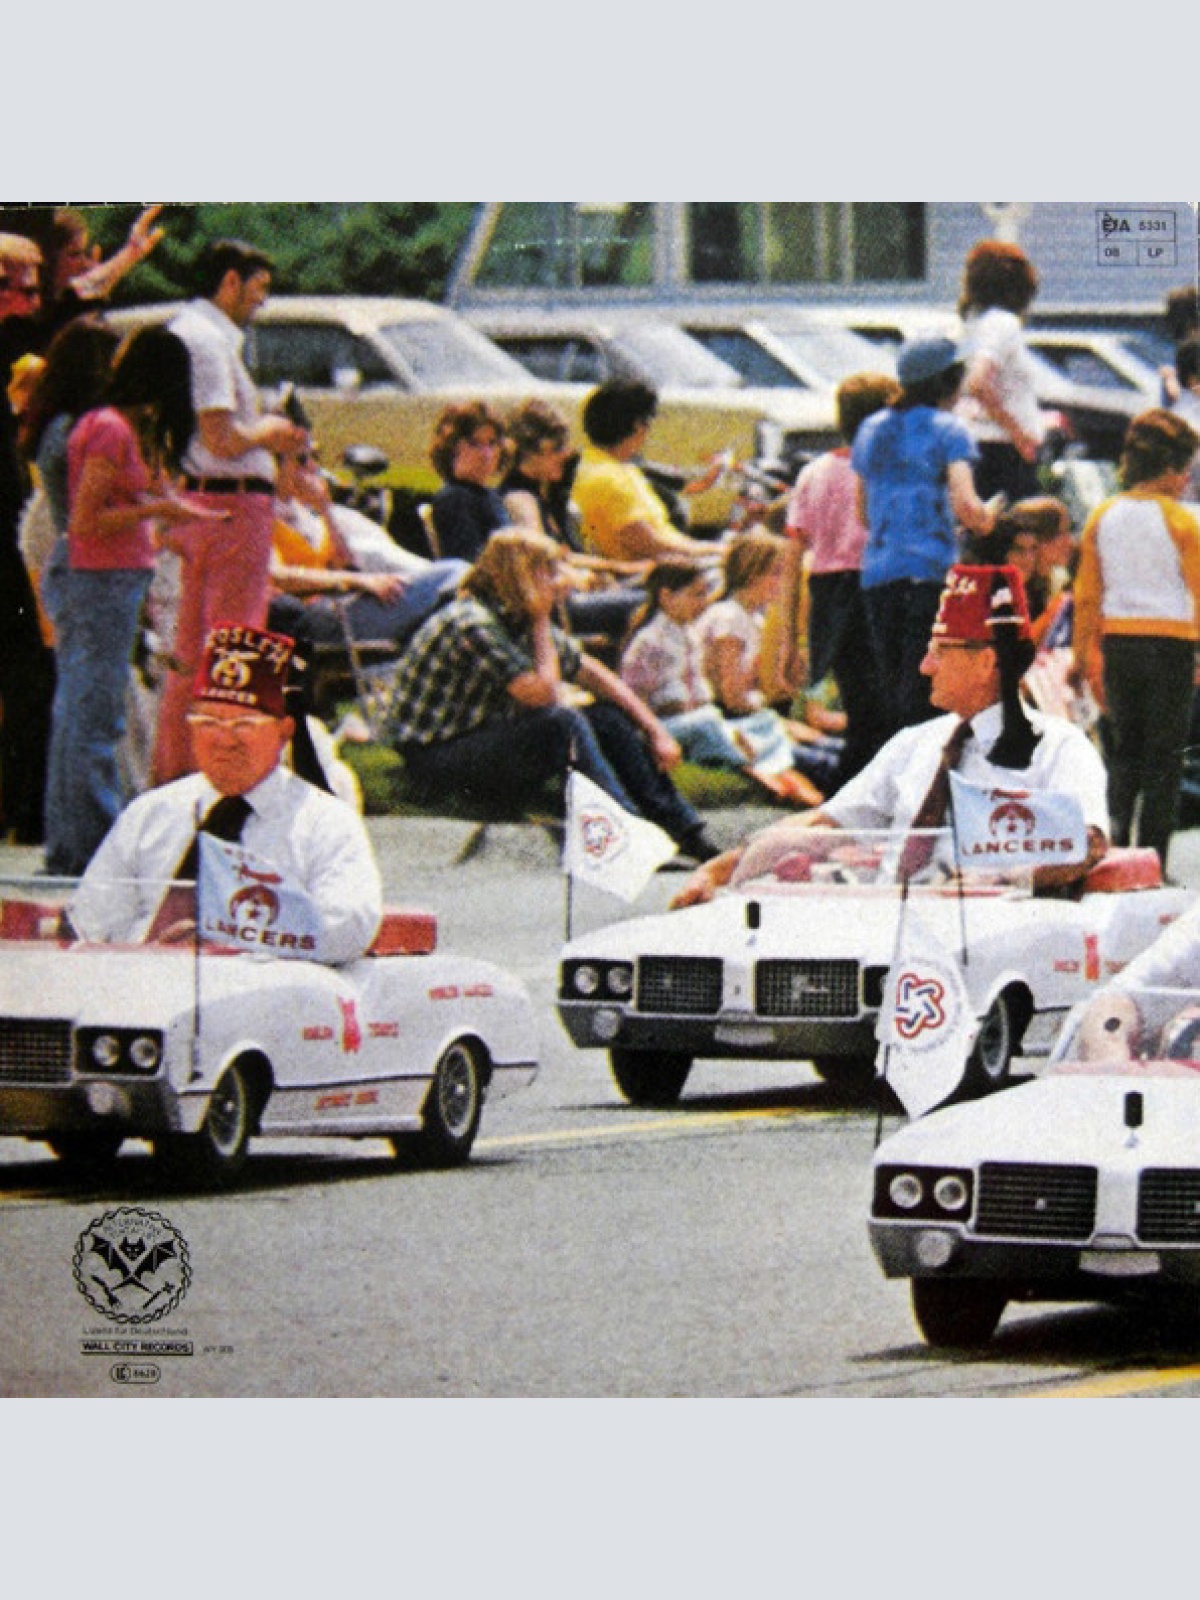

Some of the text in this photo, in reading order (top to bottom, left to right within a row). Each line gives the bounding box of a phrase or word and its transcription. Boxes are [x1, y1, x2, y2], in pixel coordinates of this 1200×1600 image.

[1147, 247, 1164, 258] LP
[962, 837, 1074, 856] LANCERS
[82, 1342, 110, 1353] WALL
[113, 1342, 138, 1353] CITY
[141, 1342, 190, 1353] RECORDS
